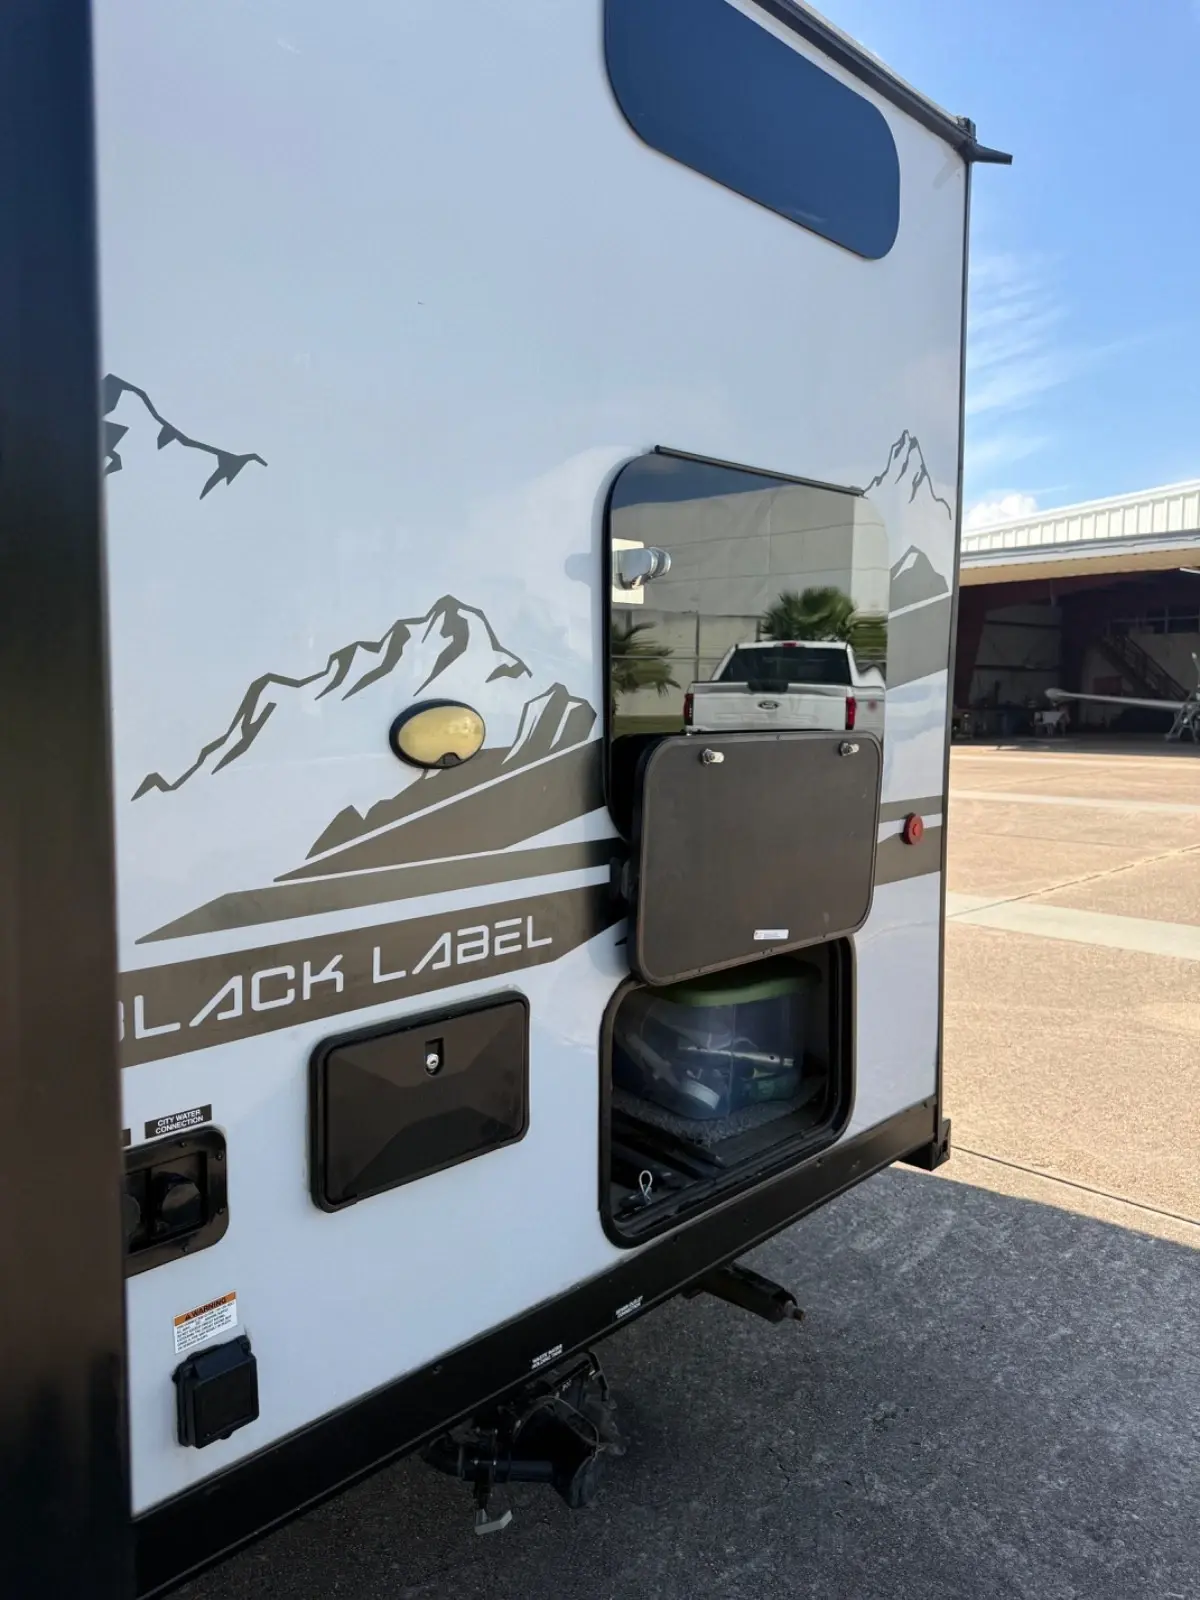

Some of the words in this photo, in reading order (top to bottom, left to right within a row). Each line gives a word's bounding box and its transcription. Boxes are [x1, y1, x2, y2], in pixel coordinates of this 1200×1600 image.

[117, 954, 344, 1042] LACK
[372, 915, 553, 984] LABEL
[155, 1116, 204, 1134] CONNECTION
[157, 1117, 175, 1127] CITY
[175, 1109, 201, 1121] WATER
[191, 1296, 226, 1318] WARNING
